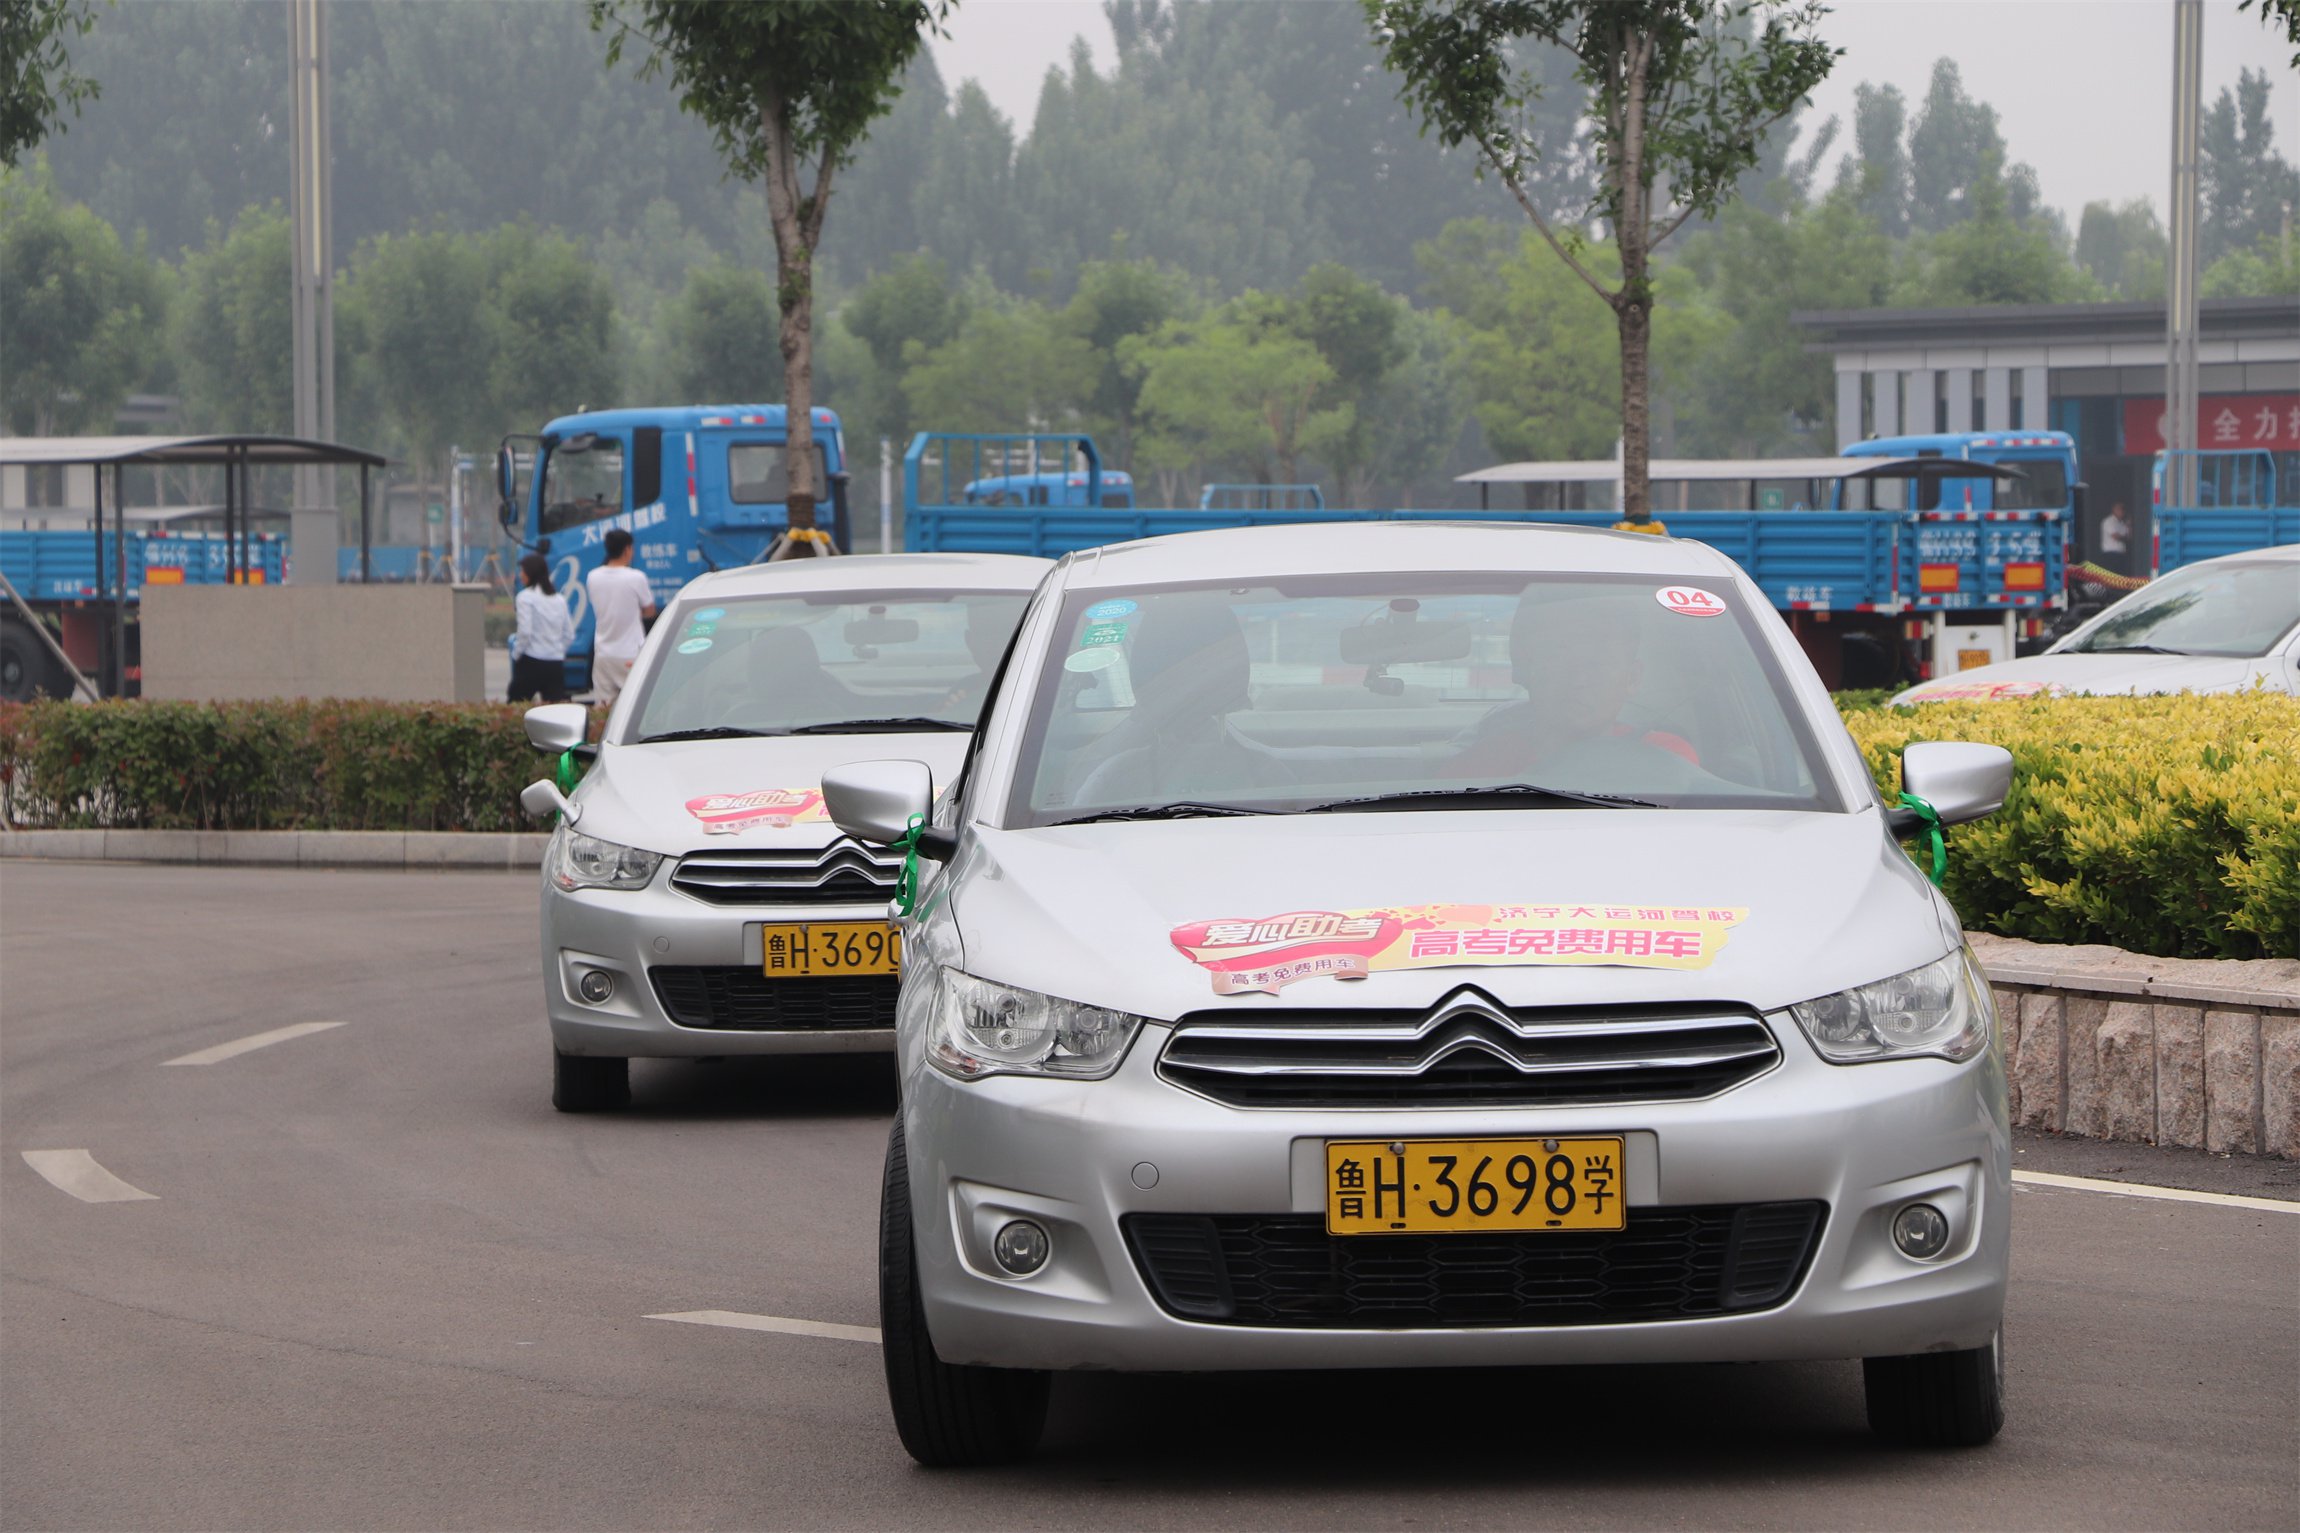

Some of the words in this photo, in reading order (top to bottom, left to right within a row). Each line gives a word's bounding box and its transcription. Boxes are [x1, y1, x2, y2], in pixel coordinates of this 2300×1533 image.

[1667, 591, 1712, 606] 04
[1786, 585, 1834, 602] 教练车
[1097, 607, 1127, 616] 2020
[1498, 905, 1737, 923] 济宁大运河驾校
[1202, 917, 1386, 947] 爱心助考
[1410, 927, 1701, 958] 高考免费用车
[1231, 957, 1356, 986] 高考免费用车
[1335, 1154, 1615, 1219] 鲁H·3698学
